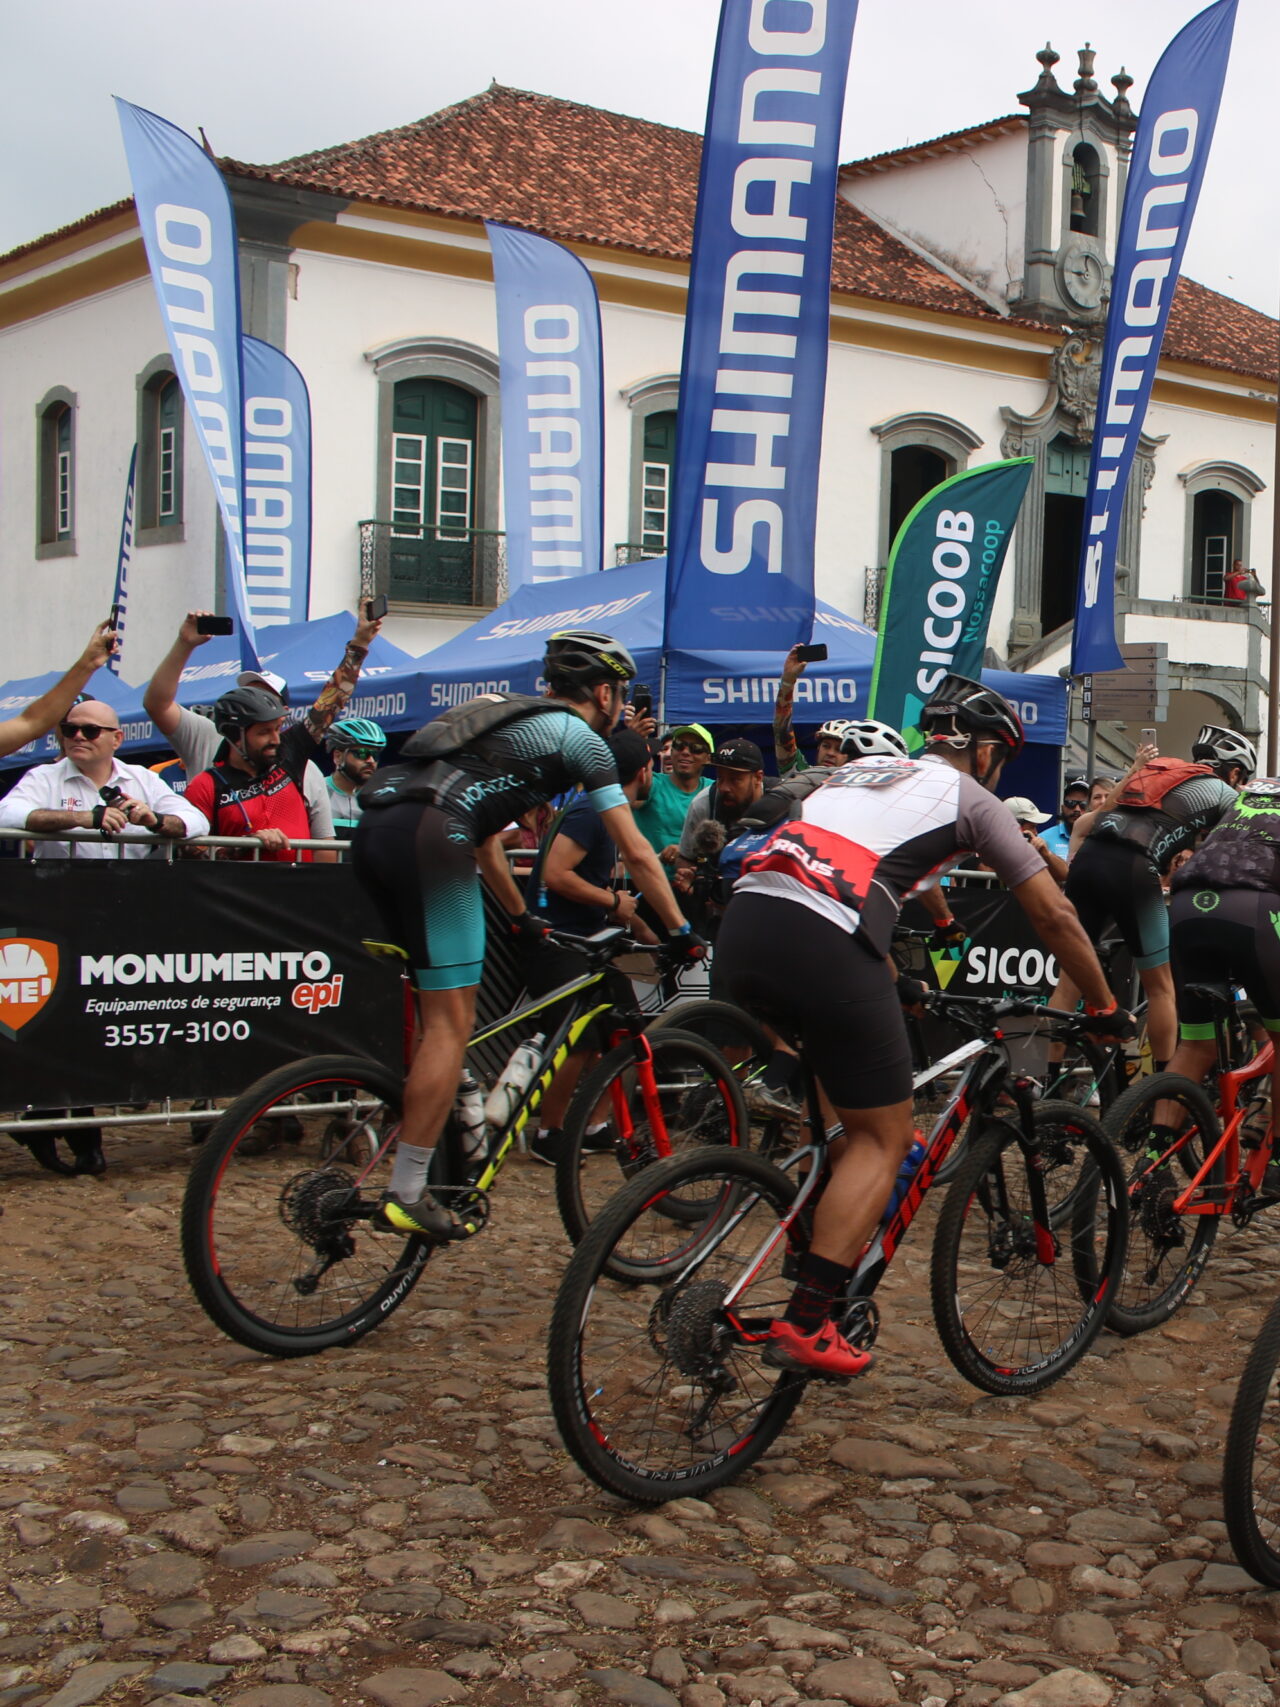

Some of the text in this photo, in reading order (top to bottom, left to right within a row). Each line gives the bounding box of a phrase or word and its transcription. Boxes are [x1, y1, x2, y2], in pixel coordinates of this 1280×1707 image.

[700, 0, 827, 576] SHIMANO
[962, 518, 1006, 644] Nossacoop
[475, 589, 653, 641] SHIMANO
[916, 508, 975, 695] SICOOB
[597, 651, 629, 679] SCOTT
[702, 677, 858, 705] SHIMANO
[840, 771, 893, 784] 161
[769, 838, 836, 878] RCUS
[80, 950, 332, 986] MONUMENTO
[85, 994, 282, 1013] Equipamentos de segurança
[291, 974, 344, 1015] epi
[104, 1019, 251, 1047] 3557-3100
